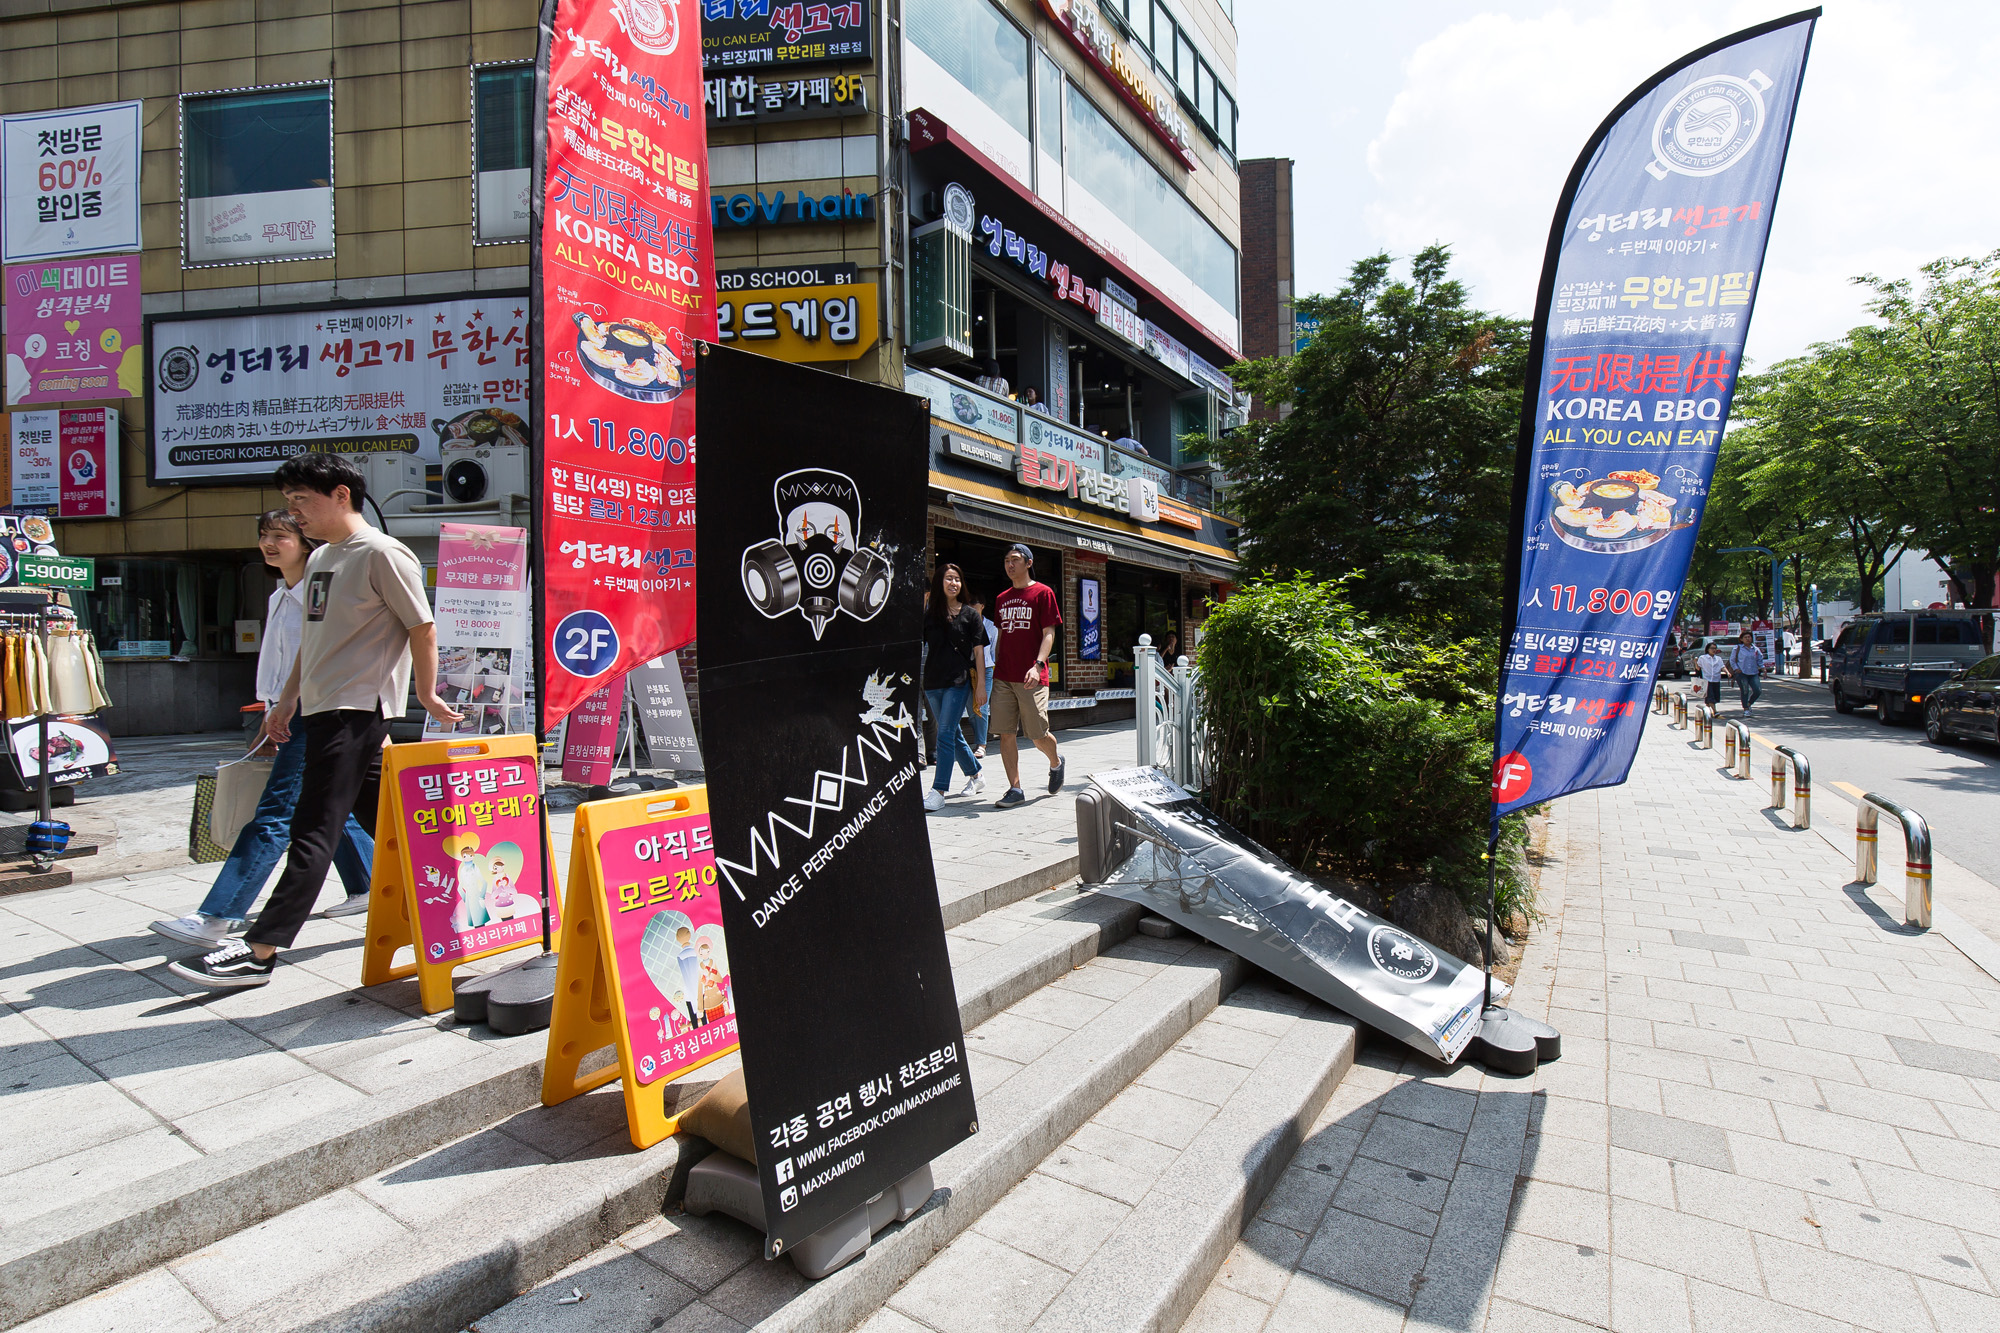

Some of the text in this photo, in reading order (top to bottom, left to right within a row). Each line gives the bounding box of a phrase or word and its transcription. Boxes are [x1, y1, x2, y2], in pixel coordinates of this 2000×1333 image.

[722, 32, 772, 46] CAN EAT
[777, 41, 862, 61] 무한리필 전문점
[599, 75, 661, 126] 두번째 이야기
[762, 74, 865, 109] 룸카페 3F
[1111, 43, 1154, 110] Room
[1153, 94, 1189, 148] CAFE
[1674, 85, 1725, 113] All you can
[37, 124, 103, 158] 첫방문
[555, 99, 699, 190] 된장찌개 무한리필
[1686, 136, 1723, 147] 무한삼겹
[38, 156, 103, 192] 60%
[37, 190, 103, 223] 할인중
[553, 165, 698, 263] 无限提供
[710, 187, 868, 228] TOV hair
[261, 220, 317, 243] 무제한
[555, 209, 700, 288] KOREA BBQ
[1618, 238, 1707, 256] 두번째 이야기
[555, 242, 703, 309] ALL YOU CAN EAT
[750, 269, 853, 288] SCHOOL B1
[1556, 271, 1755, 313] 된장찌개 무한리필
[35, 293, 112, 318] 성격분석
[326, 314, 404, 333] 두번째 이야기
[55, 338, 91, 361] 코칭
[319, 338, 415, 378] 생고기
[38, 375, 109, 392] coming soon
[1547, 350, 1732, 395] 无限提供
[443, 394, 481, 407] 된장찌개
[1546, 397, 1722, 422] KOREA BBQ
[18, 429, 53, 445] 첫방문
[237, 421, 268, 439] うまい
[375, 411, 427, 431] 食べ放題
[1542, 427, 1719, 447] ALL YOU CAN EAT
[19, 447, 39, 458] 60%
[27, 457, 52, 467] ~30%
[175, 438, 414, 463] UNGTEORI KOREA BBQ ALL YOU CAN EAT
[984, 449, 1003, 463] STORE
[550, 466, 569, 488] 한
[574, 471, 631, 500] 팀(4명)
[635, 483, 663, 506] 단위
[48, 507, 59, 515] 5F
[78, 502, 89, 511] 6F
[552, 492, 585, 515] 팀당
[588, 497, 624, 521] 콜라
[24, 563, 88, 581] 5900원
[442, 555, 520, 572] MUJAEHAN CAFE
[445, 571, 514, 586] 무제한 룸카페
[604, 575, 682, 594] 두번째 이야기
[1550, 584, 1677, 621] 11,800원
[455, 619, 501, 630] 1인 8000원
[565, 627, 611, 662] 2F
[1524, 632, 1579, 655] 팀(4명)
[1582, 636, 1616, 657] 단위
[1619, 640, 1660, 659] 입장시
[1534, 654, 1566, 675] 콜라
[600, 714, 613, 726] 분석
[1526, 719, 1602, 741] 두번째 이야기
[567, 744, 611, 759] 코칭심리카페
[417, 764, 526, 803] 밀당말고
[581, 765, 592, 777] 6F
[412, 793, 538, 836] 연애할래?
[751, 760, 918, 929] DANCE PERFORMANCE TEAM
[448, 921, 528, 952] 코칭심리카페
[1394, 964, 1428, 978] SCHOOL
[659, 1018, 739, 1067] 코칭심리카페
[769, 1041, 959, 1149] 각종 공연 행사 찬조문의
[796, 1073, 963, 1170] WWW.FACEBOOK.COM/MAXXAMONE
[800, 1149, 866, 1197] MAXXAM1001
